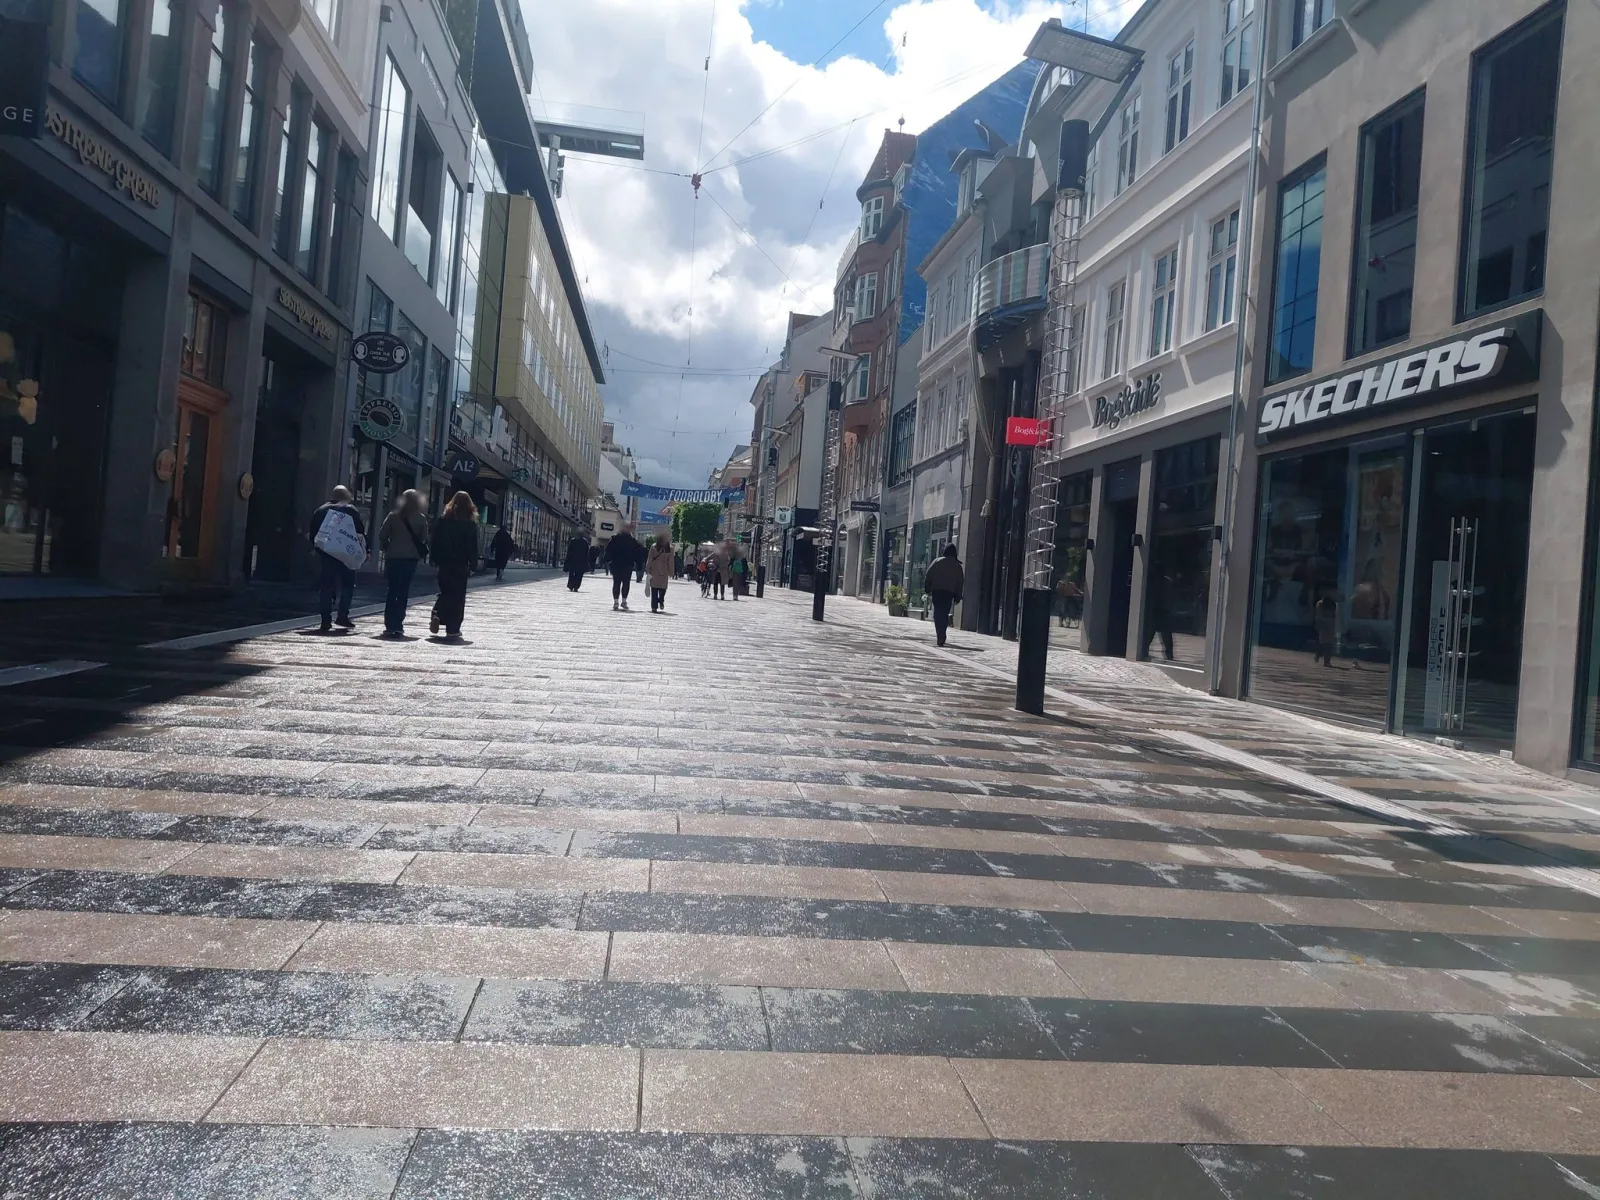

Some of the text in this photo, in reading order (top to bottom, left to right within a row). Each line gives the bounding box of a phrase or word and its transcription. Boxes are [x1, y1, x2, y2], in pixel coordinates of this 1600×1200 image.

[114, 158, 160, 210] GRENE
[1257, 327, 1514, 434] SKECHERS
[361, 398, 400, 418] ESPRESSO
[364, 425, 393, 438] HOUSE
[669, 489, 723, 503] FODBOLDBY
[338, 528, 359, 543] SILVAN
